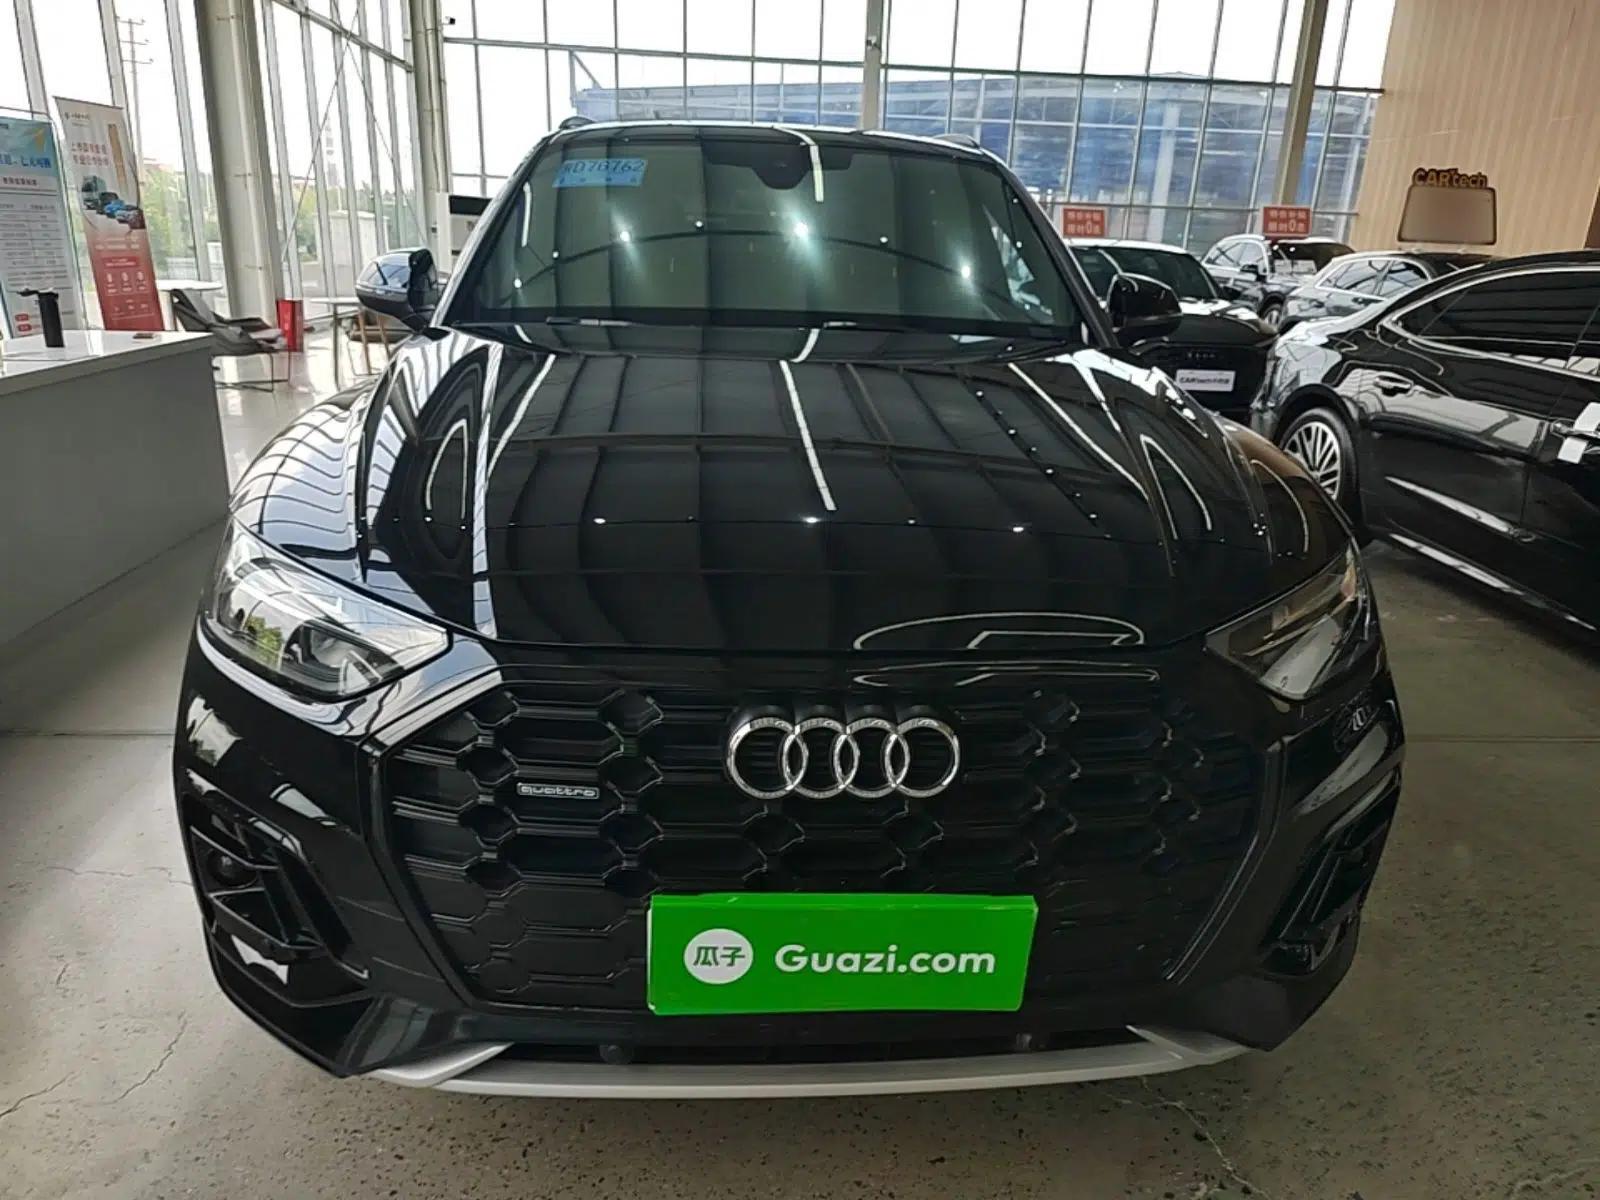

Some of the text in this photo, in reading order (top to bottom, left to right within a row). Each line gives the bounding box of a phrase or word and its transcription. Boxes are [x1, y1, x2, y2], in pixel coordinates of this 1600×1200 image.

[520, 785, 597, 798] quattro
[693, 944, 996, 975] 瓜子 Guazi.com
